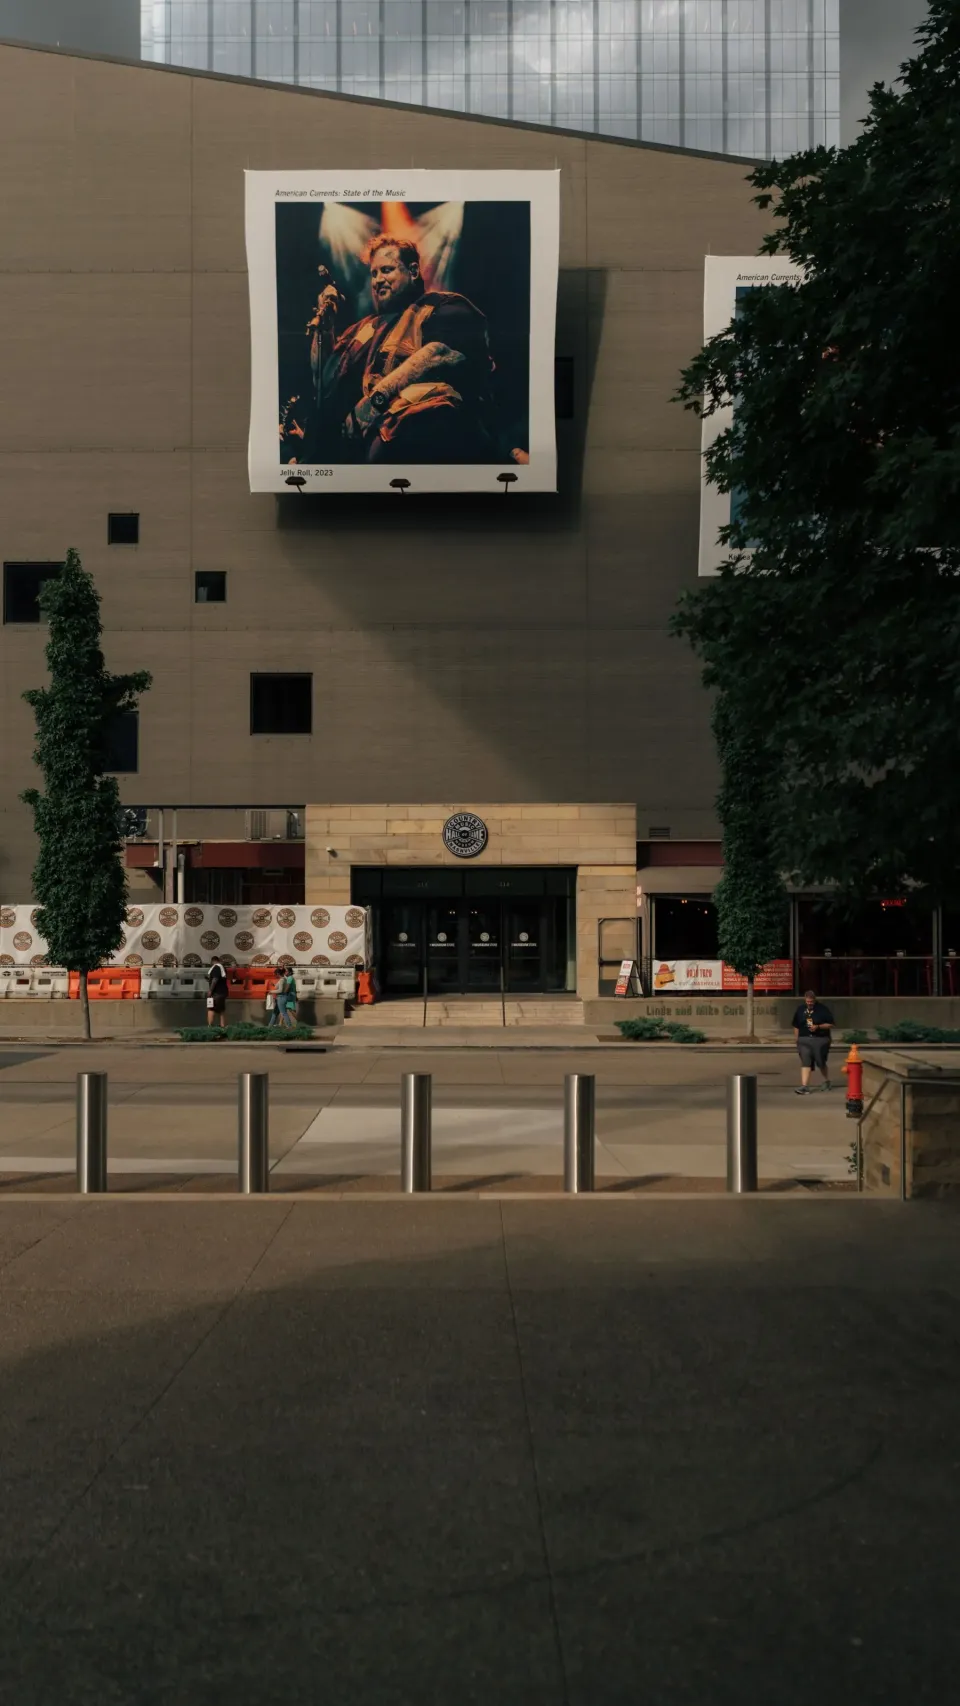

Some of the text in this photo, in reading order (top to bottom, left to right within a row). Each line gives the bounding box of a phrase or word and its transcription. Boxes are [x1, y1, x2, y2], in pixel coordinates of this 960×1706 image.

[275, 189, 406, 197] American Currents: State of the Music
[736, 273, 769, 281] American
[280, 469, 295, 477] Jelly
[297, 469, 312, 477] Roll,
[449, 816, 482, 828] COUNTRY
[454, 822, 475, 830] MUSIC
[445, 828, 460, 841] HALL
[469, 828, 484, 841] FAME
[449, 841, 482, 853] NASHVILLE
[675, 1005, 692, 1016] and
[696, 1005, 720, 1016] Mike
[723, 1005, 745, 1016] Curb
